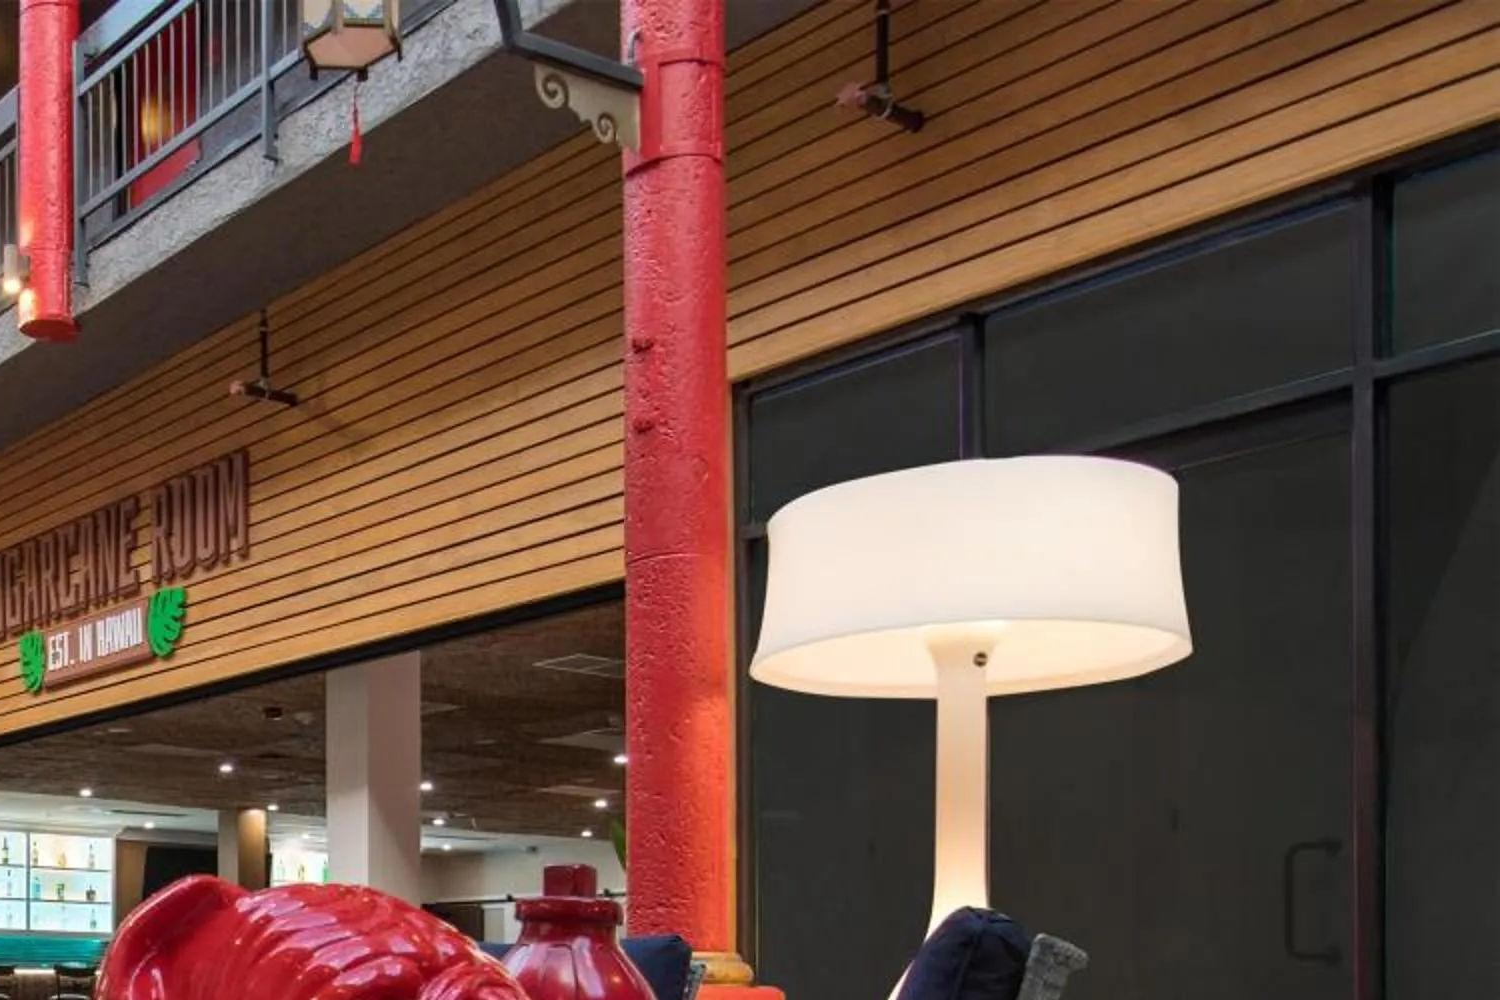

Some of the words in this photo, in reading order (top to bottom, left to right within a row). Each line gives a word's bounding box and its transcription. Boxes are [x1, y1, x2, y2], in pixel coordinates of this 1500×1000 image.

[150, 450, 249, 584] ROOM
[47, 631, 75, 672] EST.
[79, 623, 93, 663] IN
[96, 607, 143, 657] HAWAII
